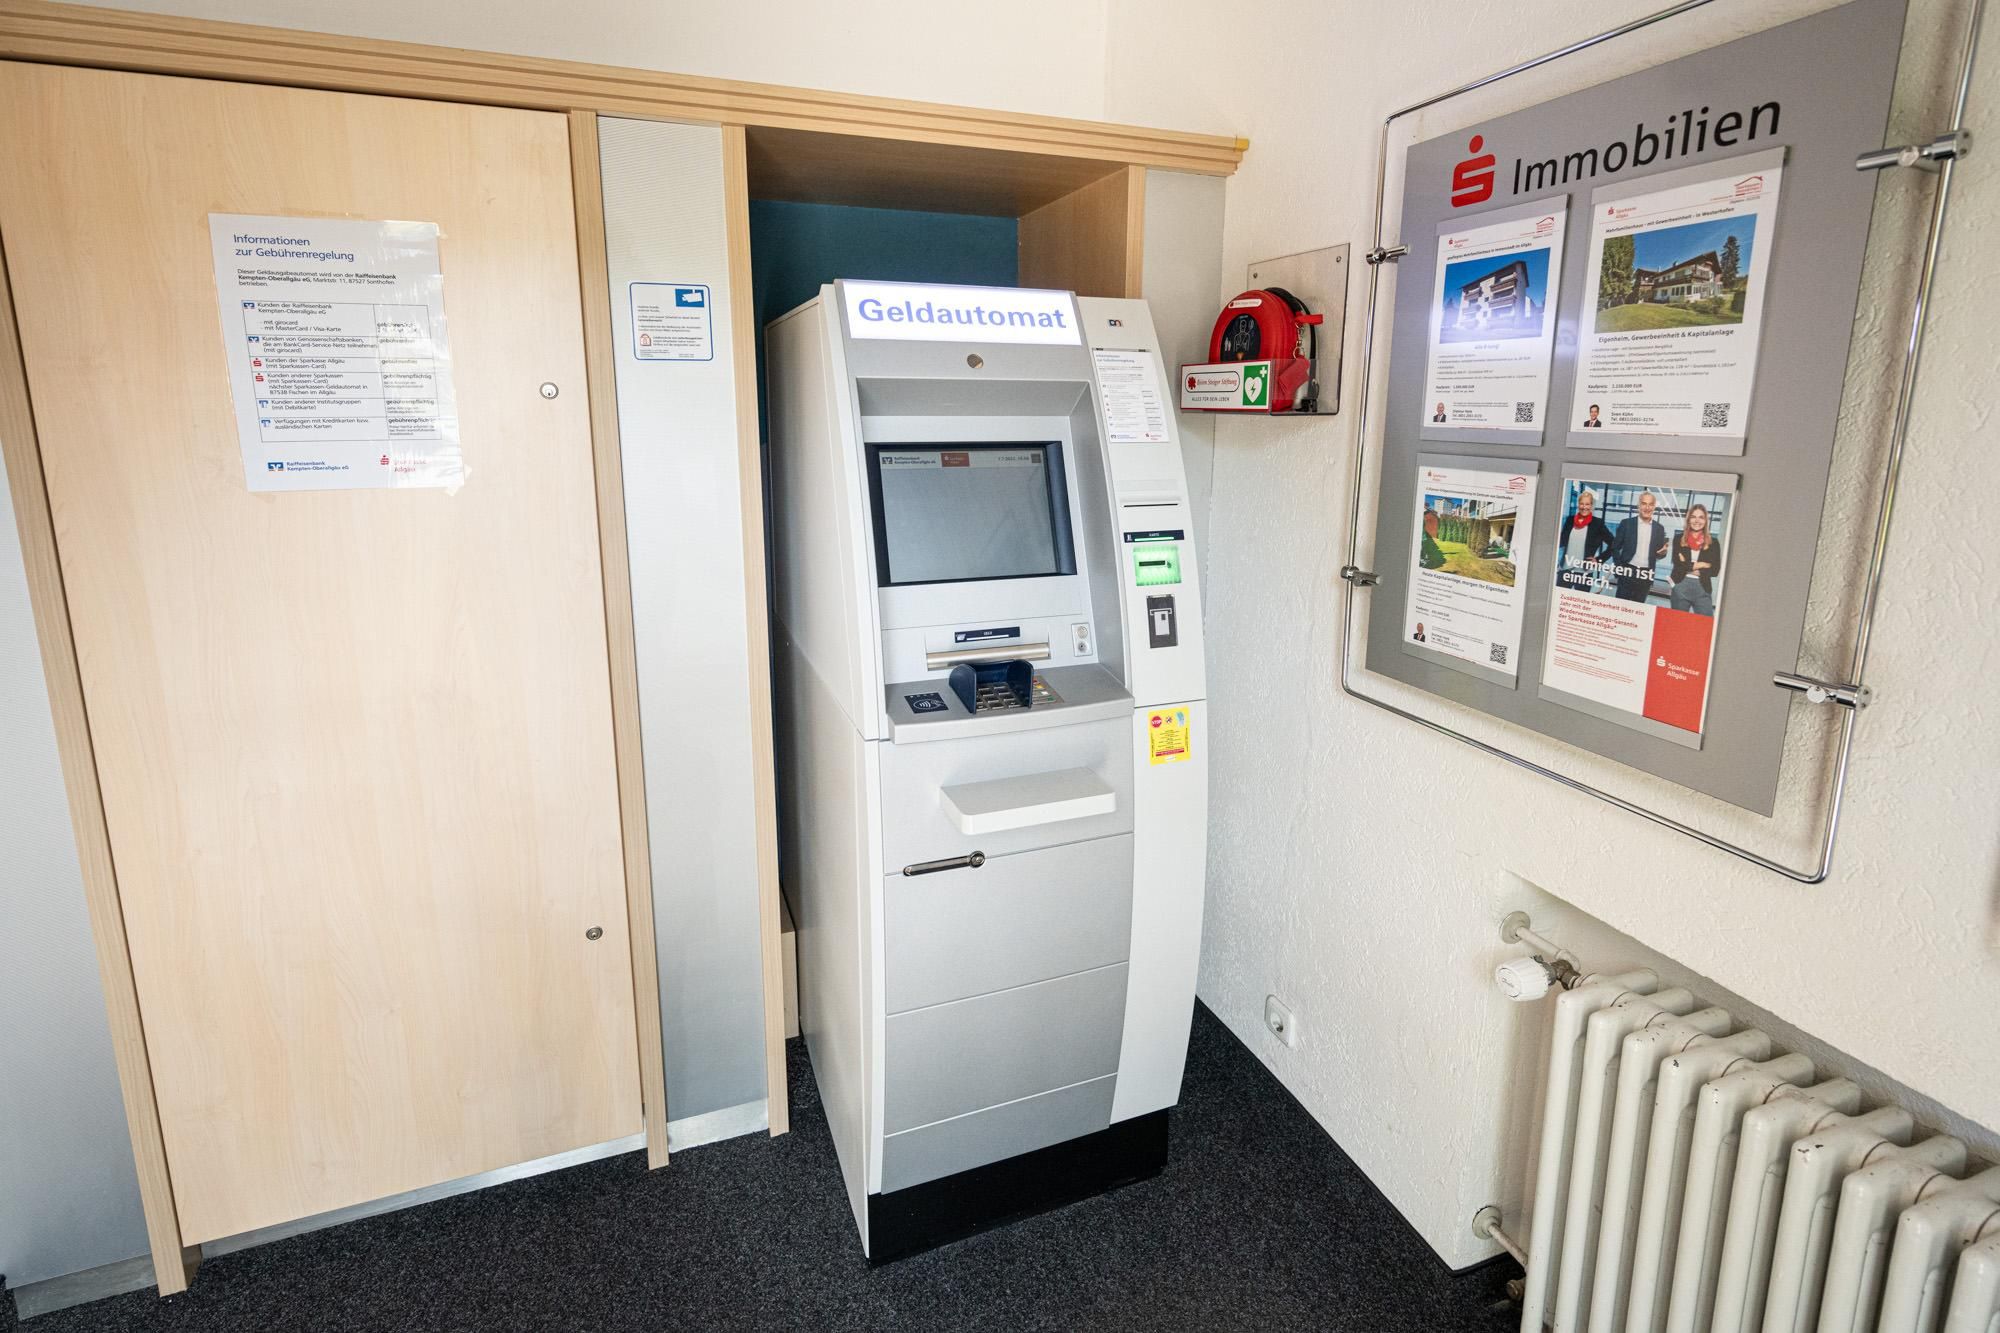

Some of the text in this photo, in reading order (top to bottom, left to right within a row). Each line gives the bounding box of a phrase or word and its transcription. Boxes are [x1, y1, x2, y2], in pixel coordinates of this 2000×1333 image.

[1512, 101, 1782, 195] Immobilien
[233, 234, 310, 246] Informationen
[235, 248, 354, 262] zur Gebührenregelung
[858, 298, 1067, 329] Geldautomat
[1631, 332, 1680, 342] Gewerbeeinheit
[1687, 328, 1734, 338] Kapitalanlage
[1564, 554, 1655, 581] Vermieten ist
[1563, 571, 1613, 590] einfach.
[1559, 600, 1571, 608] Jahr
[1560, 594, 1590, 604] Zusätzliche
[1591, 600, 1620, 611] Sicherheit
[1621, 606, 1634, 614] über
[1559, 608, 1638, 628] Wiedervermietungs-Garantie
[1568, 614, 1595, 626] Sparkasse
[1666, 670, 1687, 680] Allgäu
[1668, 662, 1700, 676] Sparkasse
